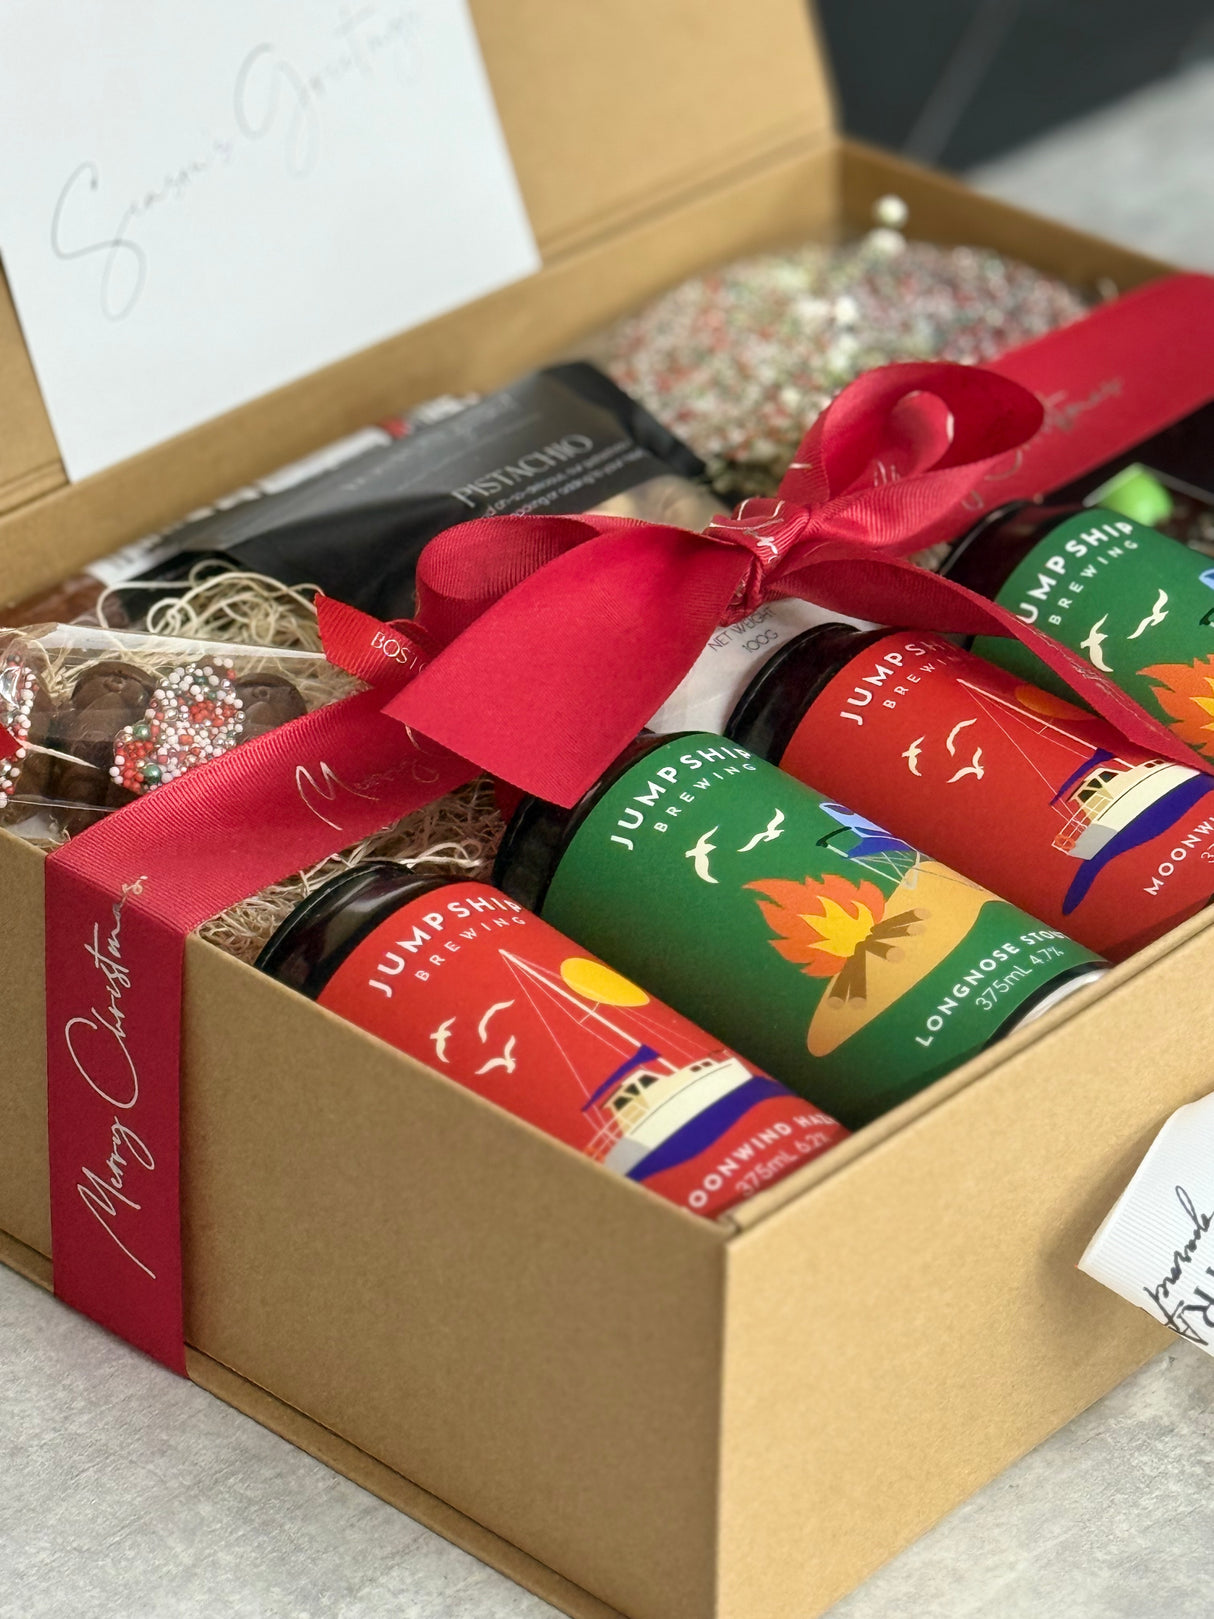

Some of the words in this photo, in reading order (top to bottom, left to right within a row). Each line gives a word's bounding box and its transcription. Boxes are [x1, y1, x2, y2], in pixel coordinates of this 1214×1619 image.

[452, 433, 594, 508] PISTACHIO
[1016, 555, 1066, 624] UMP
[1048, 540, 1138, 625] BREWING
[708, 631, 732, 652] NET
[731, 606, 776, 635] WEIGHT
[840, 652, 903, 726] JUMP
[610, 766, 678, 851] JUMP
[680, 747, 751, 770] SHIP
[654, 763, 757, 833] BREWING
[369, 912, 444, 998] JUMP
[447, 897, 522, 918] SHIP
[414, 917, 526, 982] BREWING
[975, 965, 1033, 1011] 375mL
[65, 875, 148, 1110] Christmas
[915, 943, 1020, 1047] LONGNOSE
[77, 1115, 155, 1280] Merry
[688, 1122, 793, 1208] OONWIND
[792, 1113, 840, 1128] HAZ
[1143, 1185, 1214, 1333] gourmet
[1168, 1265, 1214, 1345] RA
